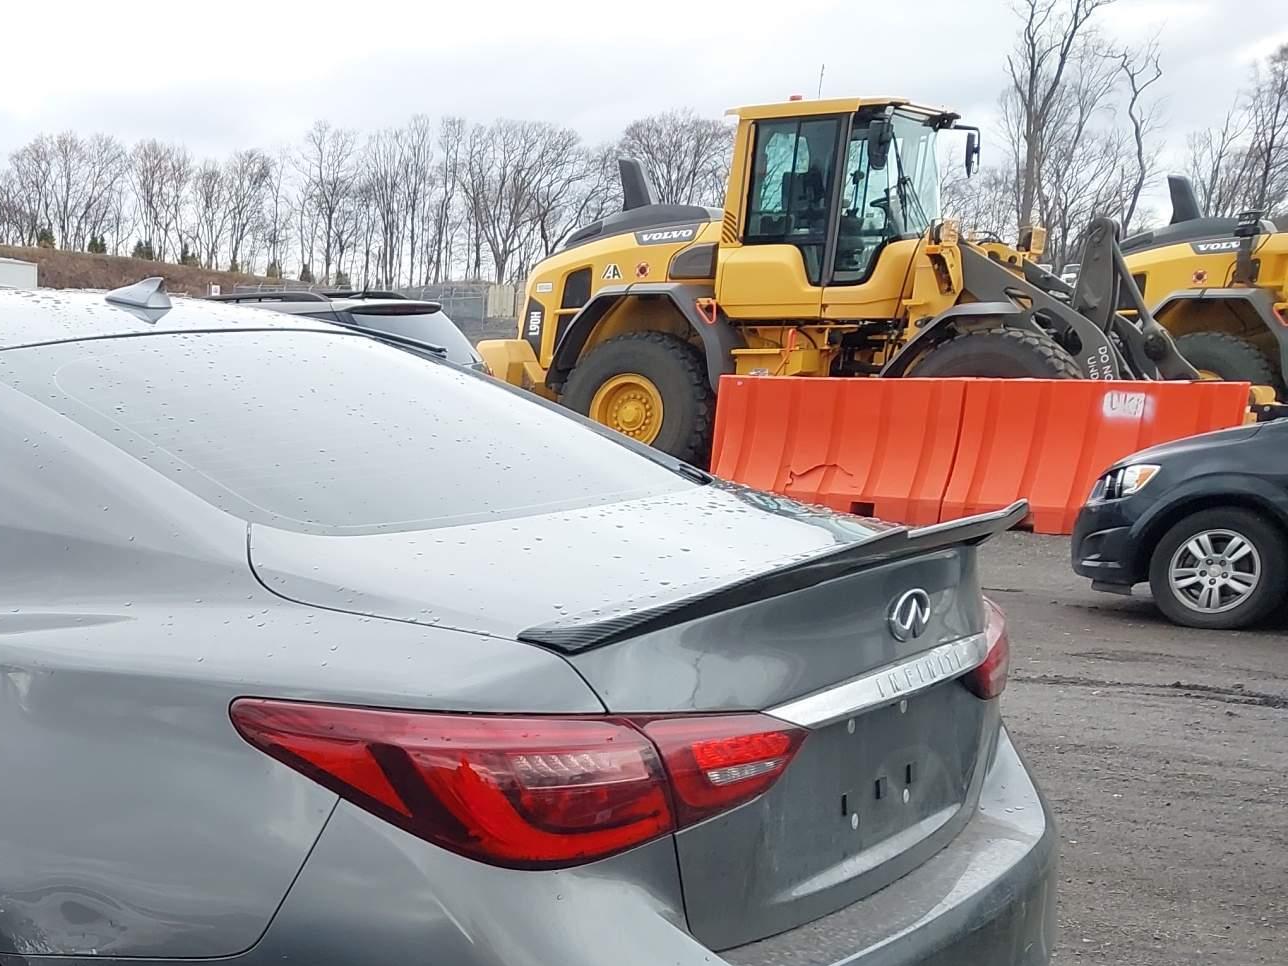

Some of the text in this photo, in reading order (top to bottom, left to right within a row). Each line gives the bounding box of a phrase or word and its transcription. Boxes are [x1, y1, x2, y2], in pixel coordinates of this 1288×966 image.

[642, 229, 693, 242] VOLVO
[1198, 241, 1240, 251] VOLV
[528, 311, 541, 336] L90H
[1088, 356, 1099, 380] UND
[1098, 346, 1113, 380] DO NO
[876, 649, 962, 698] INFINITI
